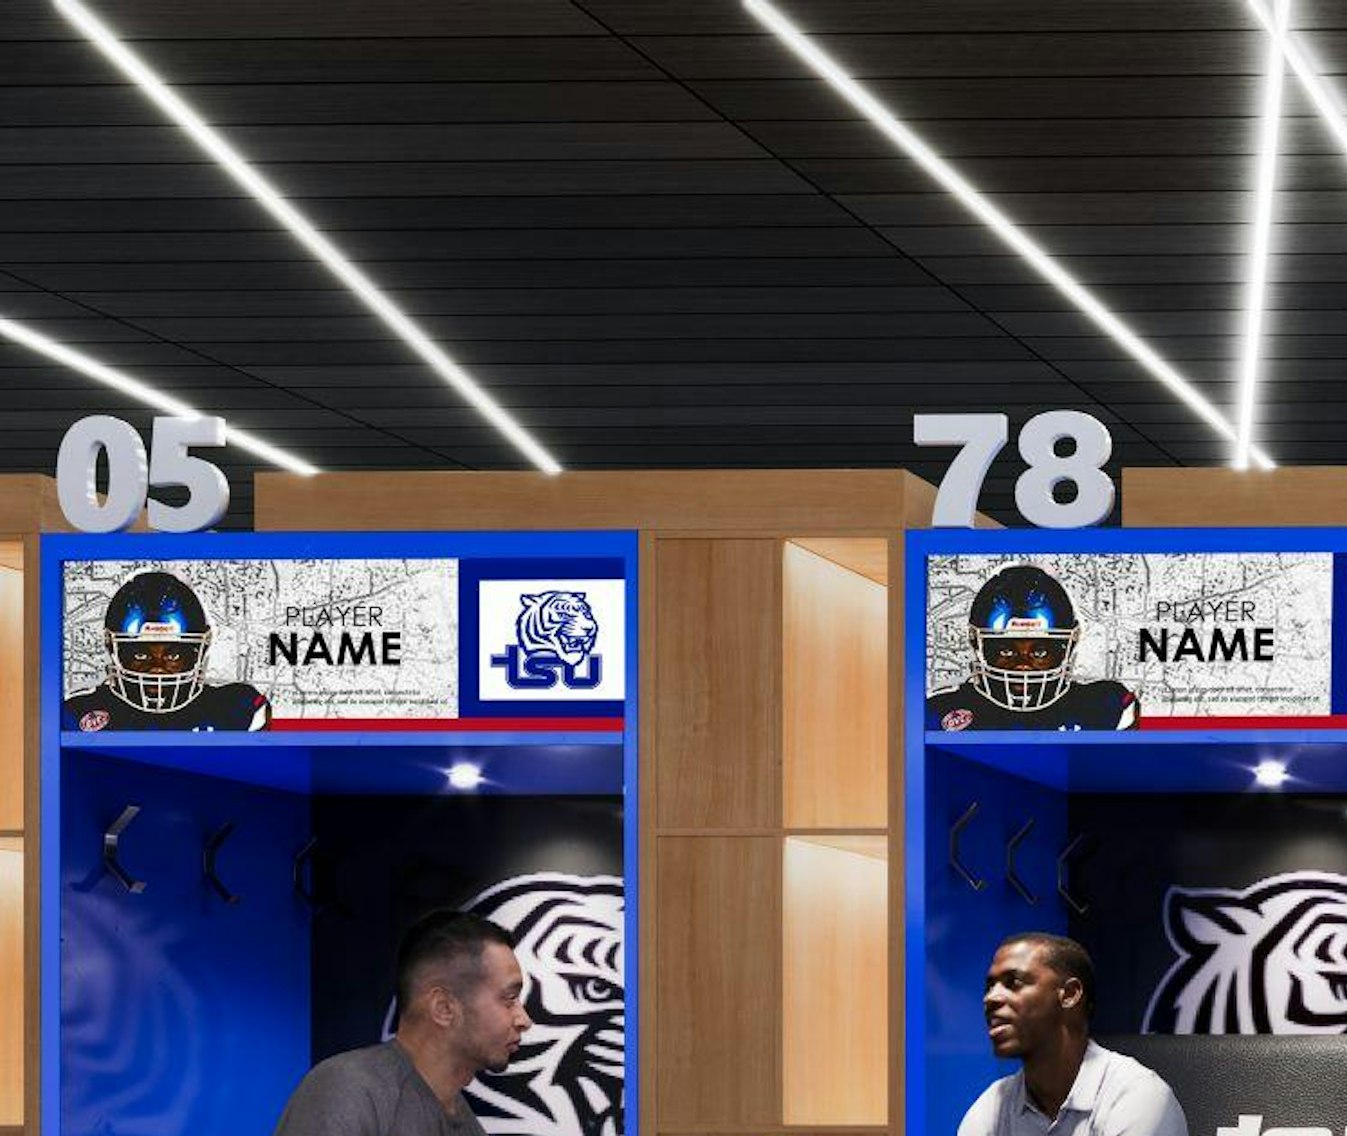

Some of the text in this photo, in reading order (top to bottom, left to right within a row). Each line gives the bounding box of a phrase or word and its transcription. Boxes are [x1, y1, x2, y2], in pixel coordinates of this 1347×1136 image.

[56, 414, 230, 533] 05
[913, 410, 1115, 528] 78
[286, 605, 383, 627] PLAYER
[1155, 600, 1255, 622] PLAYER
[269, 631, 401, 666] NAME
[1138, 627, 1274, 662] NAME
